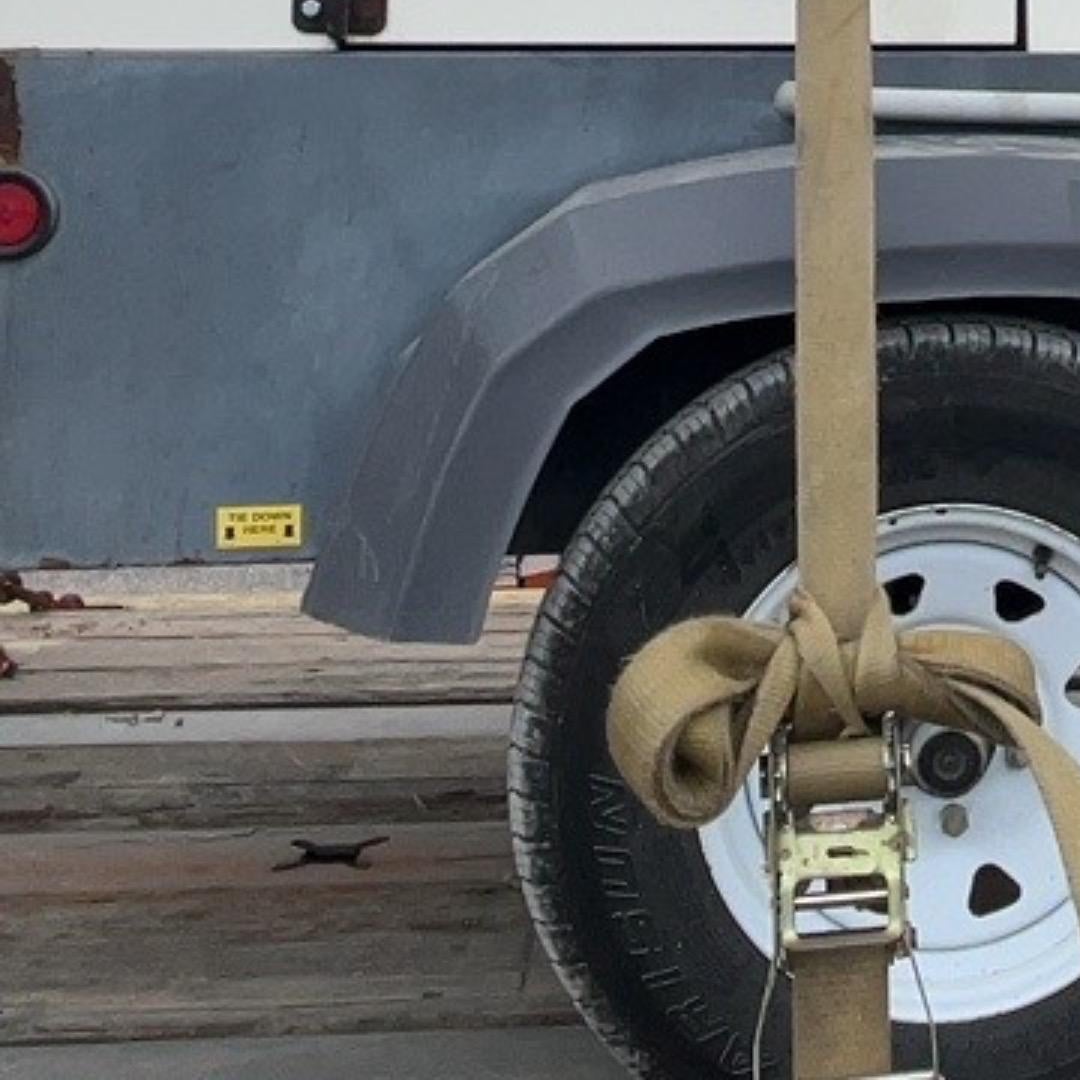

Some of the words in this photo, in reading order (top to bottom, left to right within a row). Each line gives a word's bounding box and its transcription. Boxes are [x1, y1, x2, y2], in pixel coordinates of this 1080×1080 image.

[228, 512, 247, 523] TIE
[251, 511, 292, 523] DOWN
[242, 524, 277, 535] HERE
